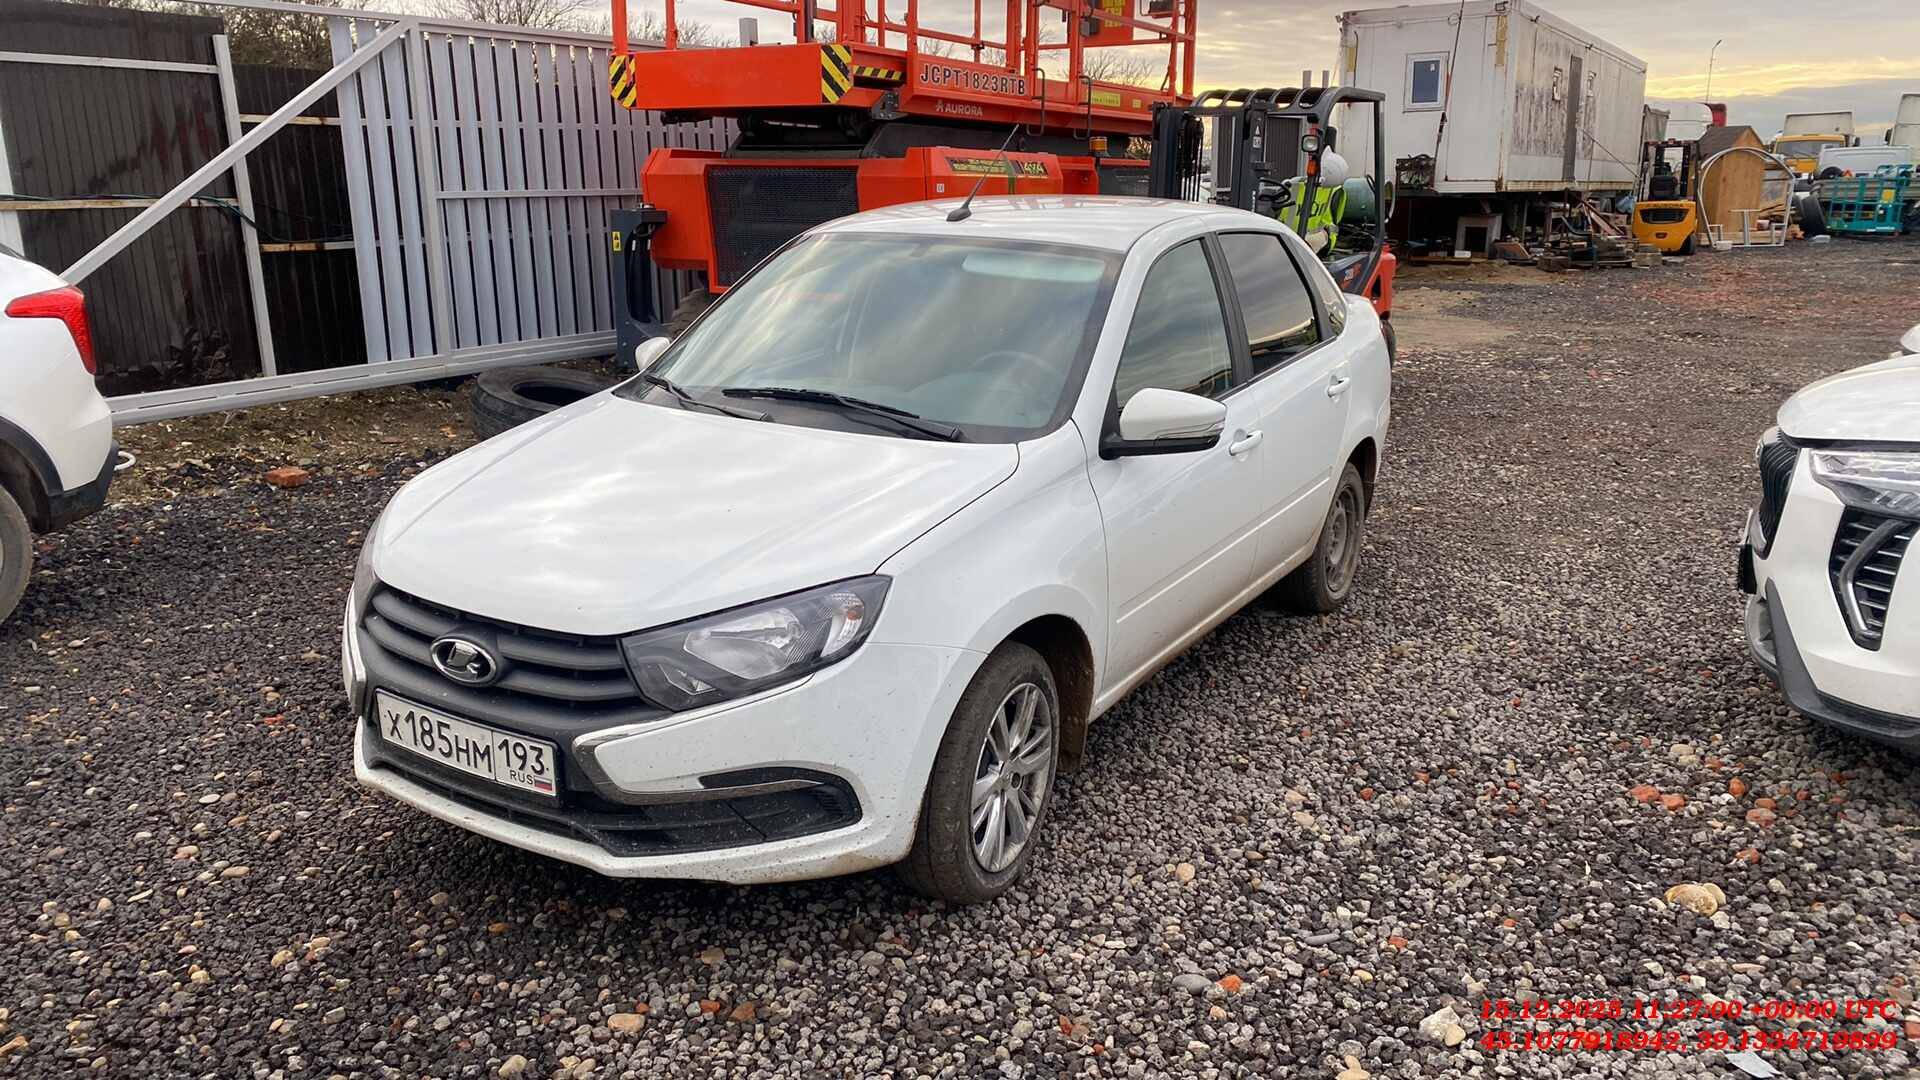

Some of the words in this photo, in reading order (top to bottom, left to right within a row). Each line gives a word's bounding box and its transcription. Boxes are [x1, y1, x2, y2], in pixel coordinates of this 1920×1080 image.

[920, 64, 1026, 95] JCPT1823RTB
[945, 102, 983, 117] AURORA
[498, 738, 546, 776] 193
[509, 770, 534, 786] RUS
